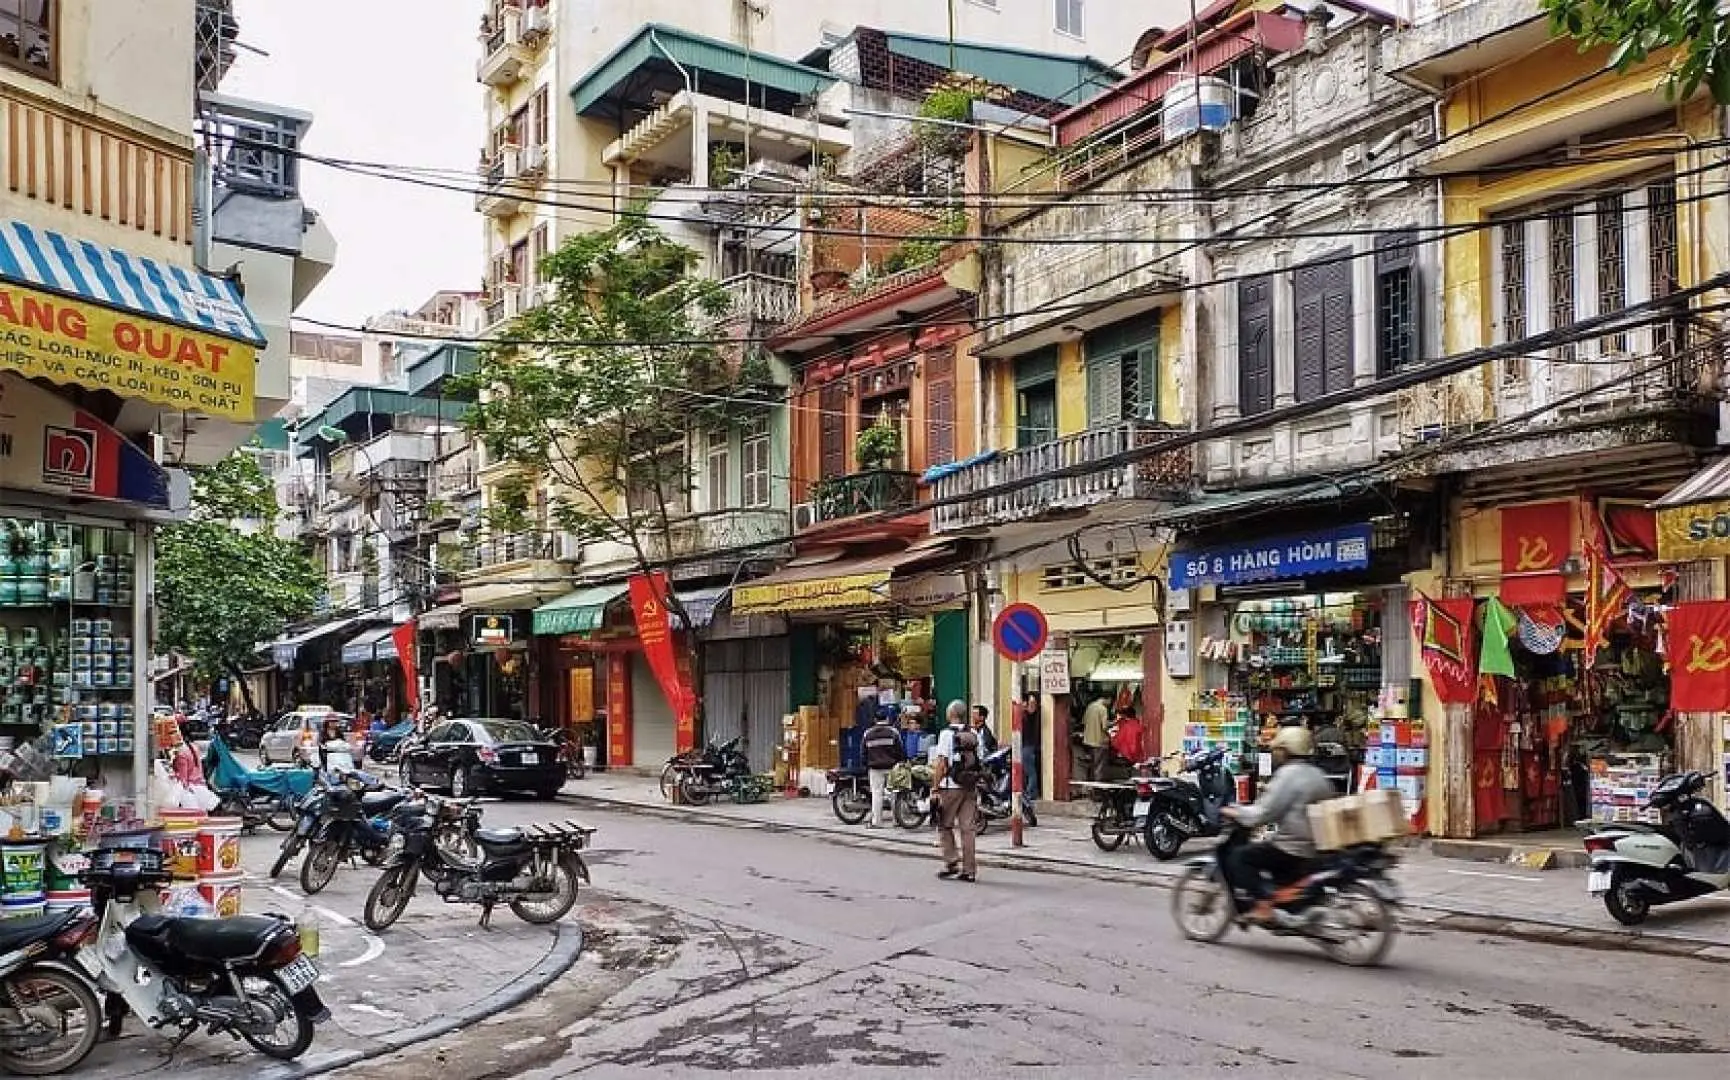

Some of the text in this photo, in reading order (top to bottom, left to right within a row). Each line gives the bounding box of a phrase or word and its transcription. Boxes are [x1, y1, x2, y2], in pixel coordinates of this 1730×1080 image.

[114, 322, 228, 373] QUẠT
[129, 359, 142, 373] IN
[1214, 556, 1224, 573] 8
[1231, 548, 1280, 571] HÀNG
